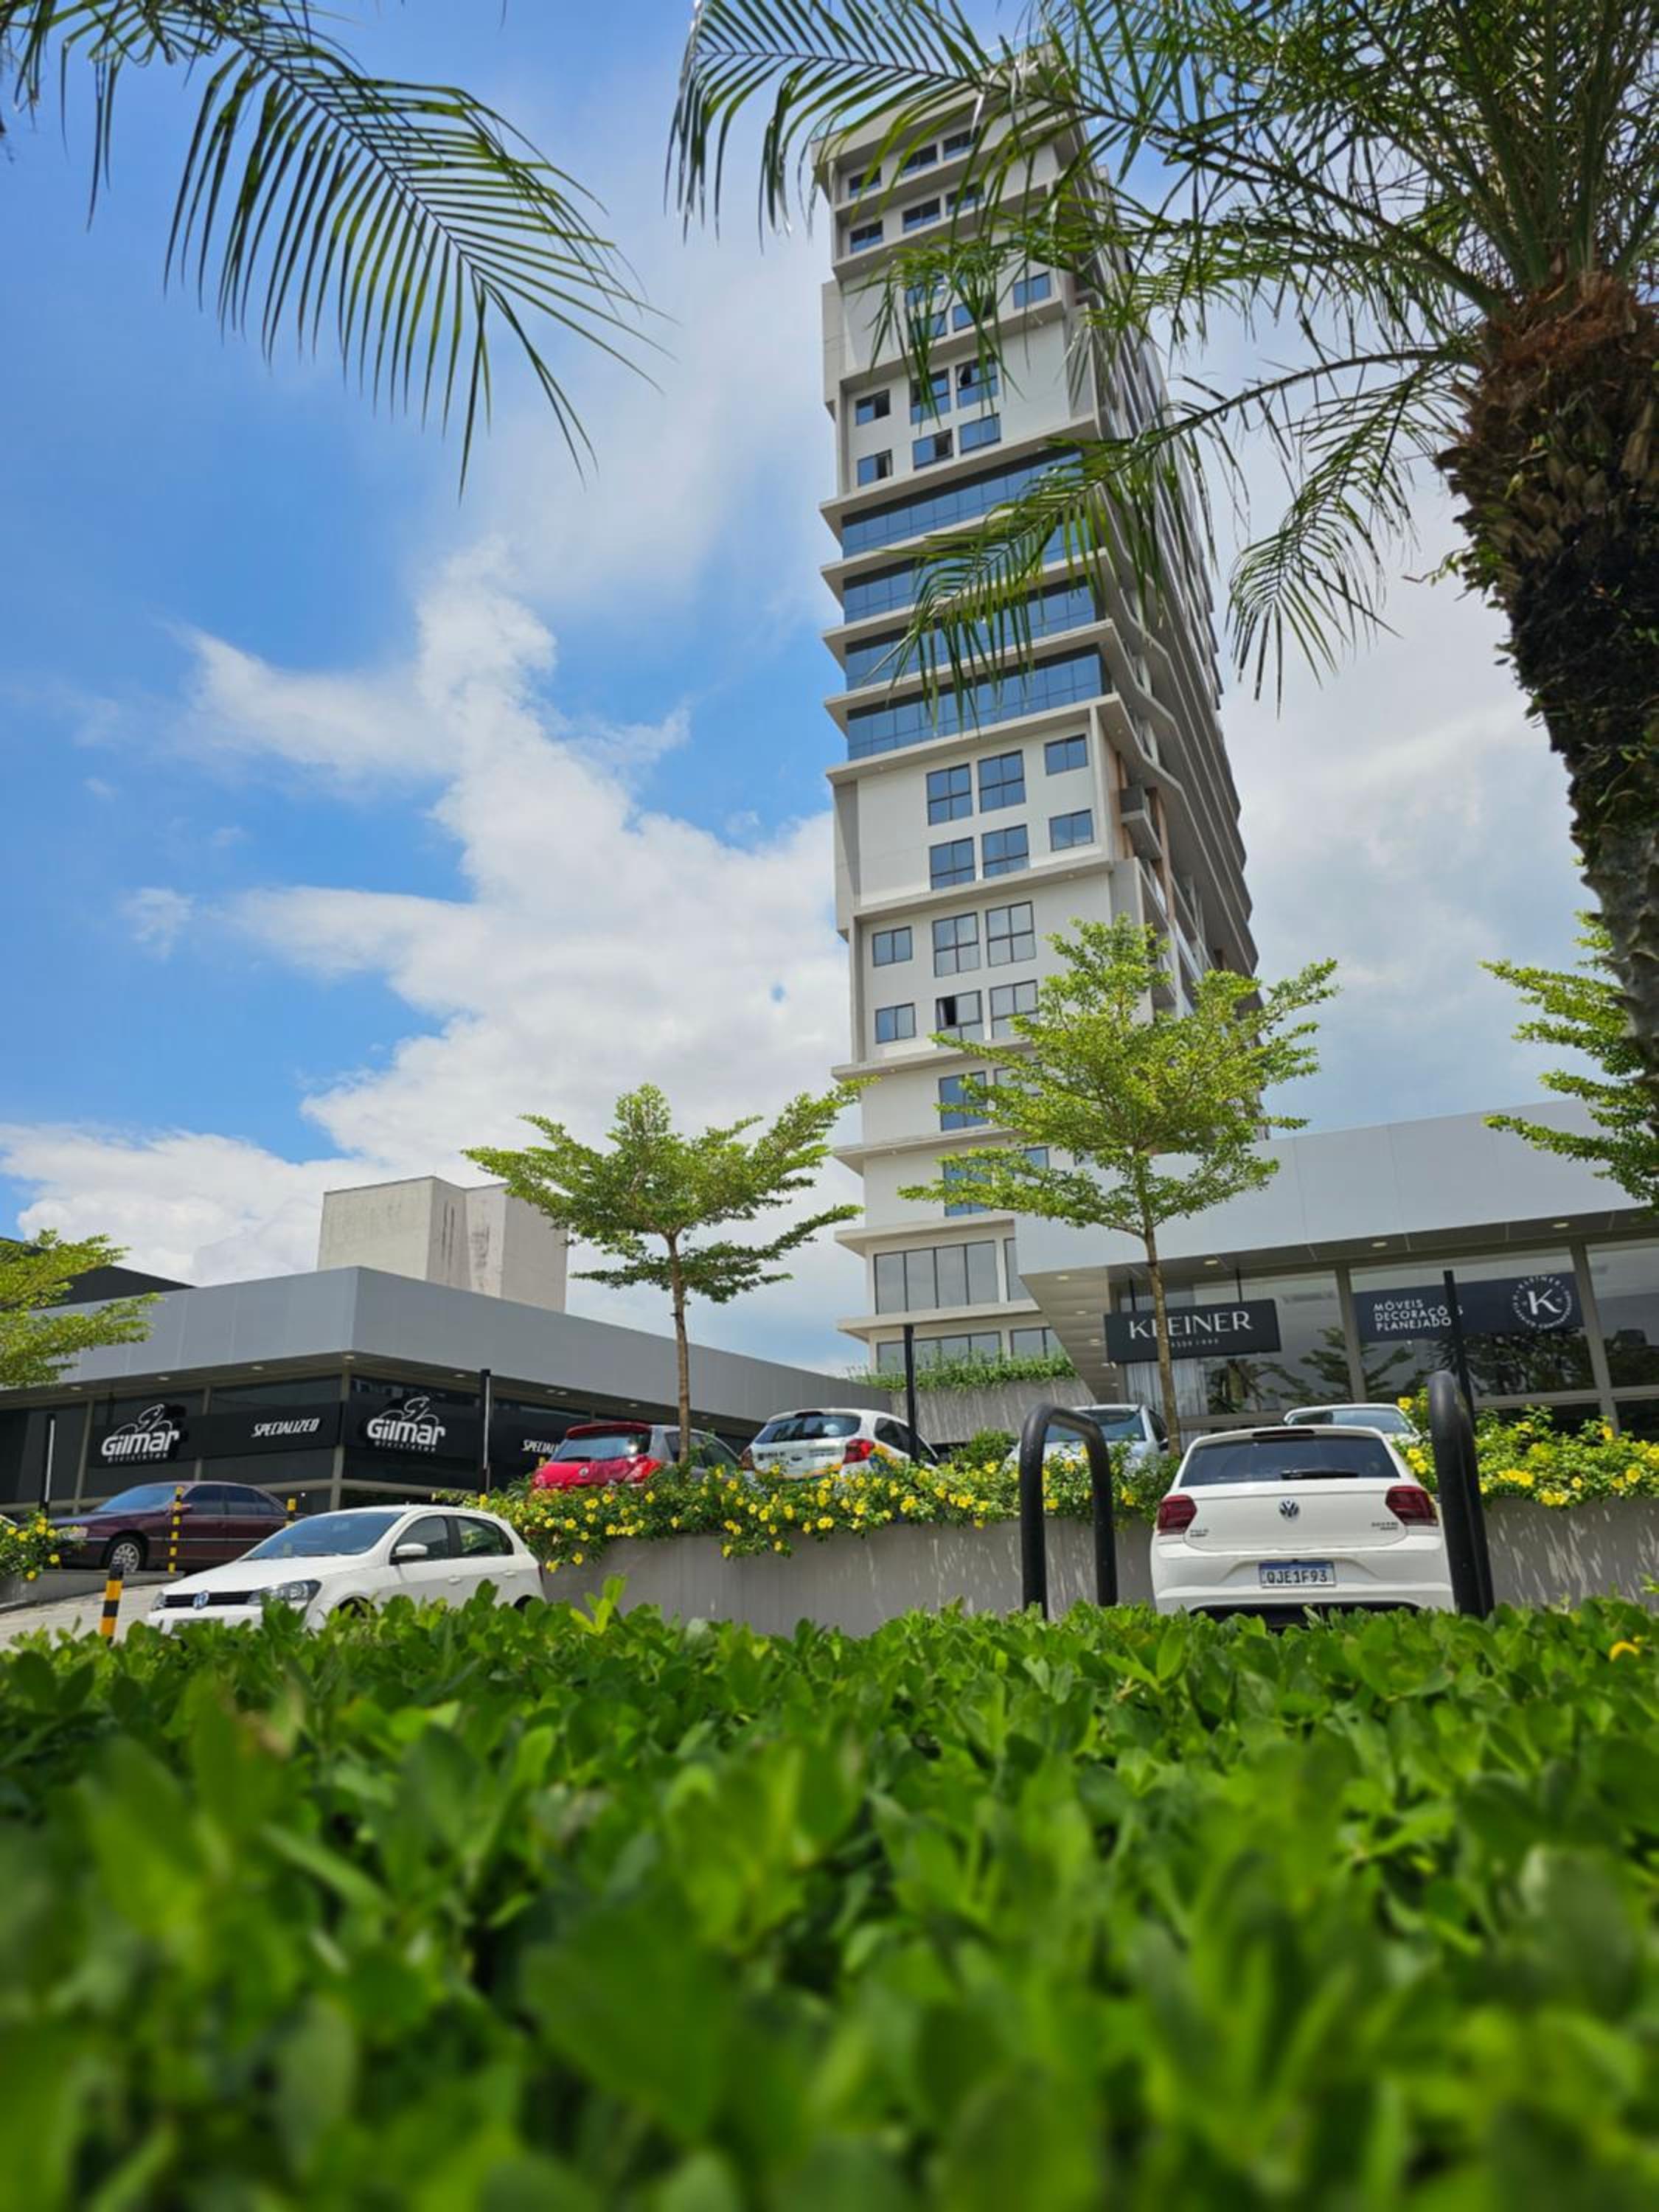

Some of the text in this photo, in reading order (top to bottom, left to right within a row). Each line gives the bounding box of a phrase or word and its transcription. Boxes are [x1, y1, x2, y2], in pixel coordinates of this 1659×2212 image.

[1374, 1305, 1464, 1322] DECORAÇÕS
[1528, 1289, 1562, 1315] K
[251, 1417, 320, 1438] SPECIALIZED
[366, 1418, 446, 1446] Gilmar
[101, 1430, 180, 1456] Gilmar
